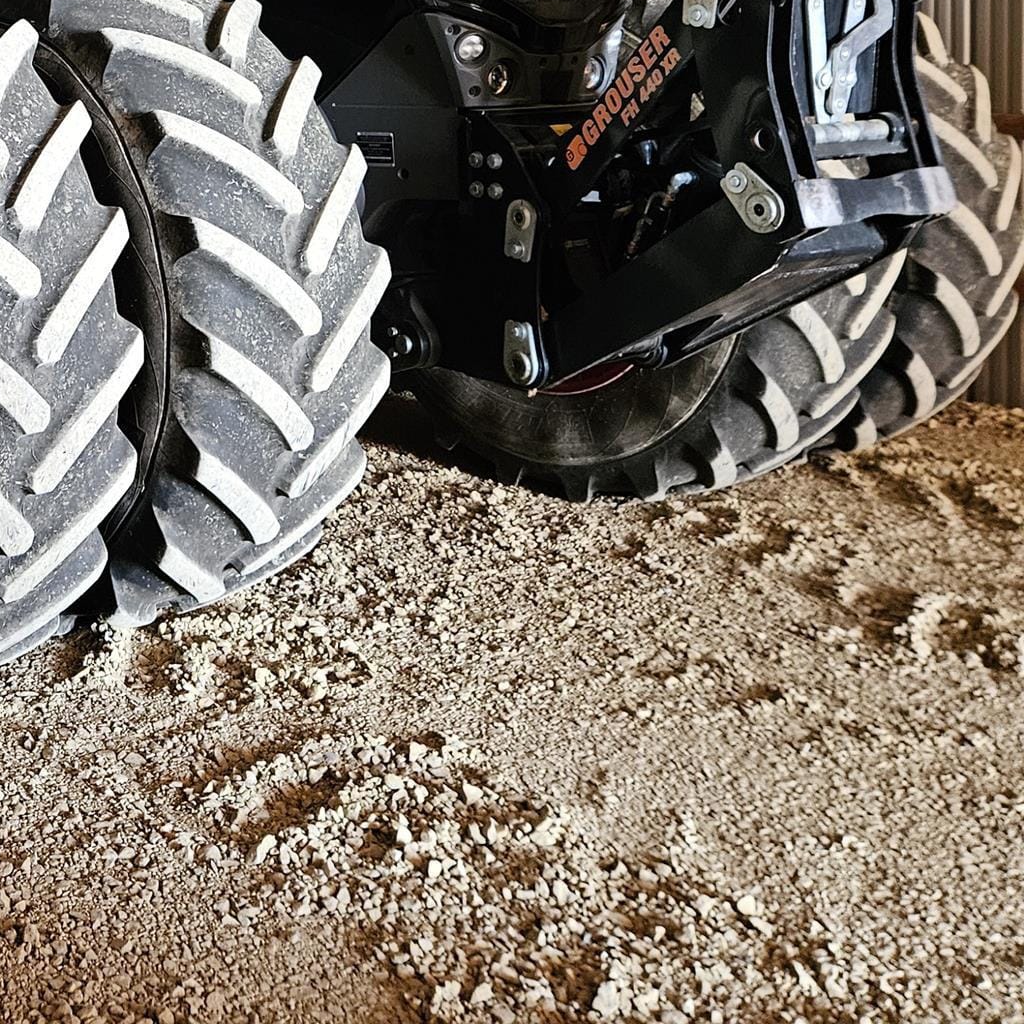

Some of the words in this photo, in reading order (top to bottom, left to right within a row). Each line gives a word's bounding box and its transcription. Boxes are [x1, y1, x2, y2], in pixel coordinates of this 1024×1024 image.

[581, 25, 671, 146] GROUSER
[620, 98, 640, 127] FH
[639, 69, 663, 103] 440
[659, 47, 682, 76] XR
